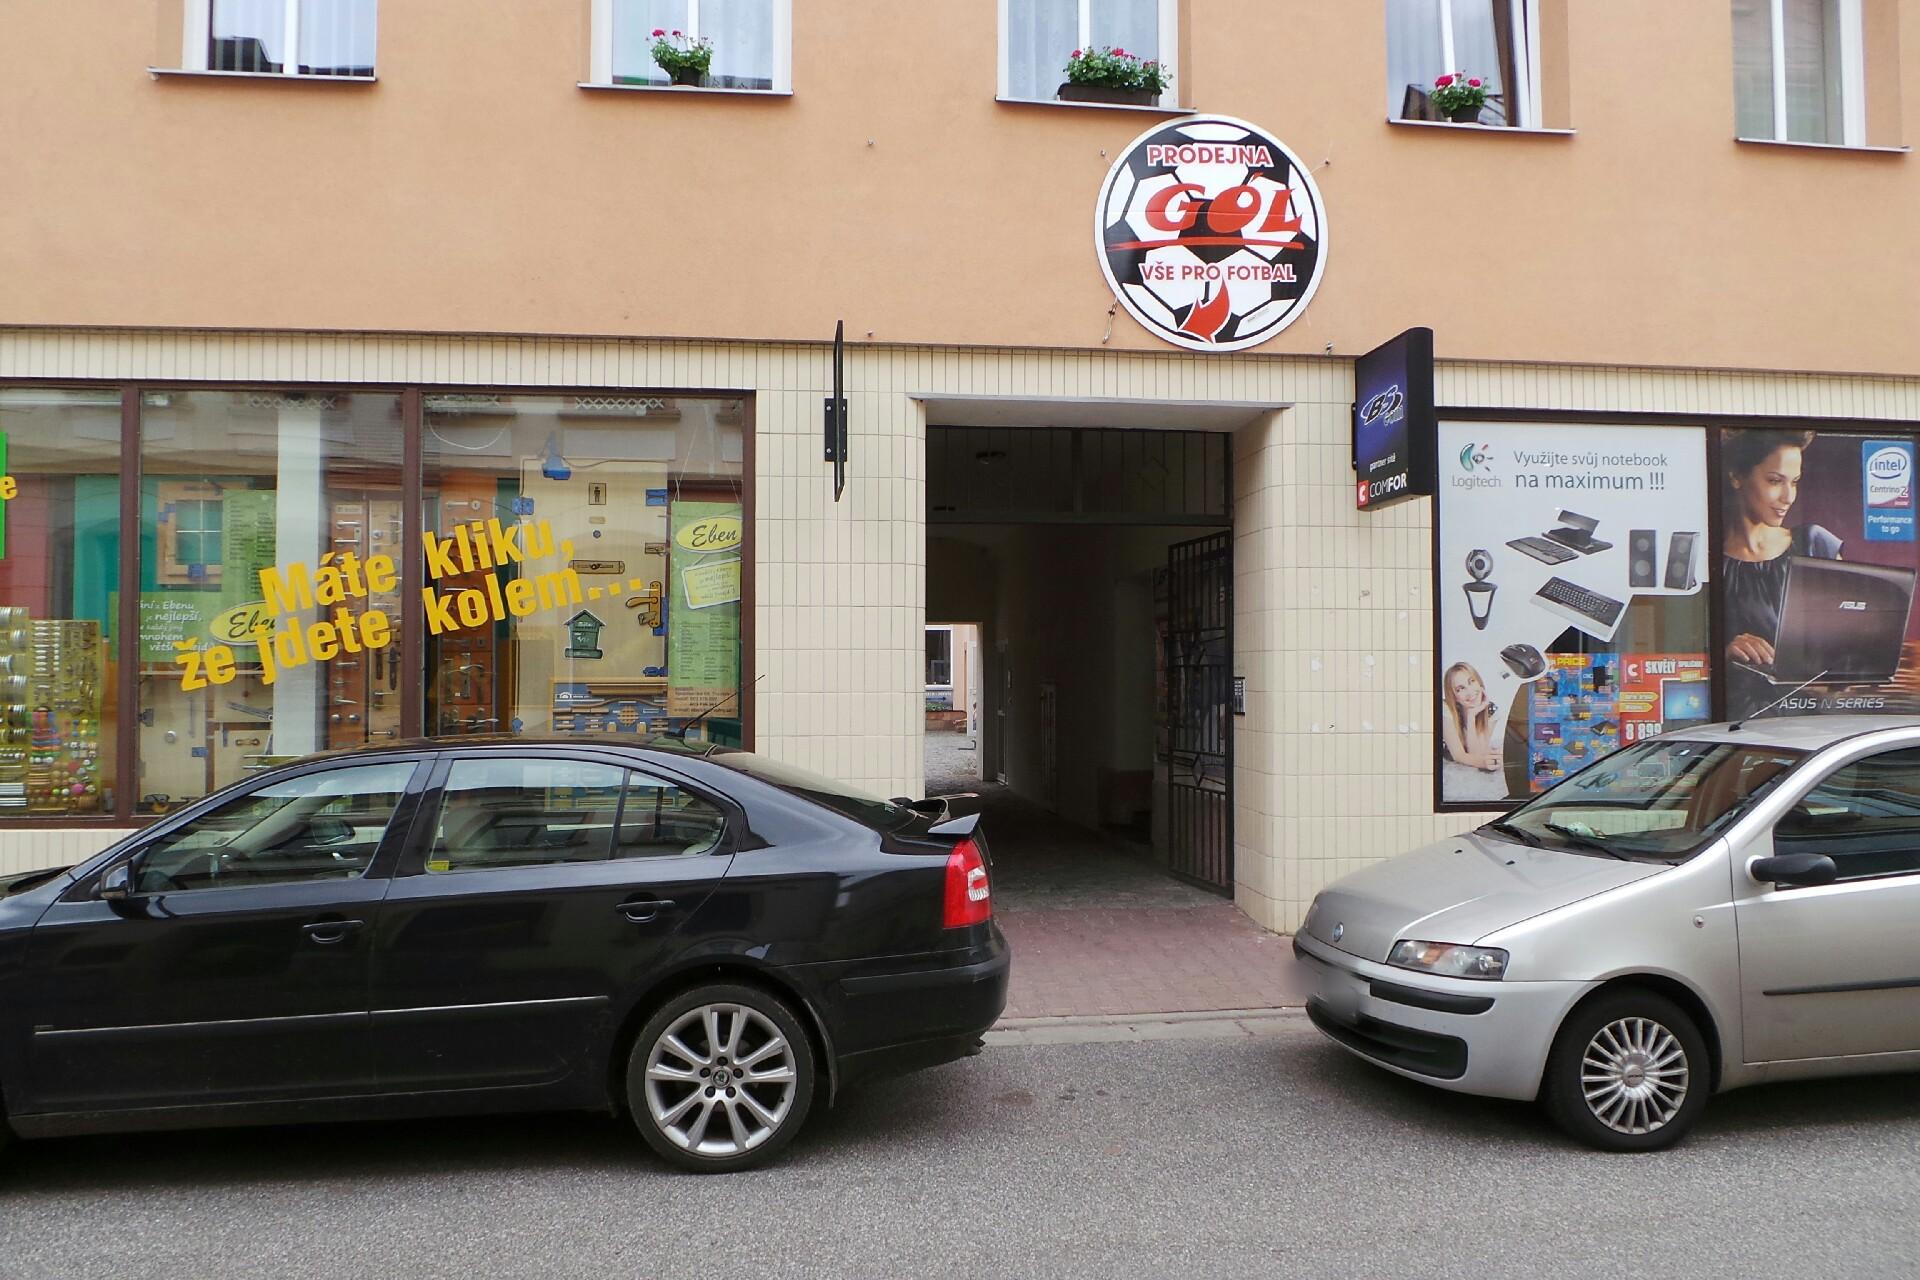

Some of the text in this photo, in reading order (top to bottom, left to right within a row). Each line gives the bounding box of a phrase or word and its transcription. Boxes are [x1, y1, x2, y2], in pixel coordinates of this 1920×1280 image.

[1149, 146, 1271, 166] PRODEJNA
[1144, 172, 1303, 234] GÓL
[1140, 261, 1296, 281] VŠE PRO FOTBAL
[1514, 450, 1668, 468] Využijte svůj notebook
[1874, 459, 1901, 471] intel
[1370, 472, 1407, 498] COMFOR
[1452, 475, 1501, 490] Logitech
[1515, 472, 1665, 491] na maximum !!!
[1870, 485, 1899, 494] Centrino
[1868, 515, 1912, 525] Performance
[691, 524, 738, 548] Eben
[1882, 525, 1900, 535] to go
[258, 551, 397, 616] Máte
[423, 517, 574, 578] kliku,
[162, 600, 195, 610] Ebenu
[175, 635, 236, 692] že
[256, 606, 393, 686] jdete
[422, 566, 643, 635] kolem...
[1645, 658, 1677, 674] SKVĚLÝ
[1779, 697, 1885, 709] ASUS N SERIES
